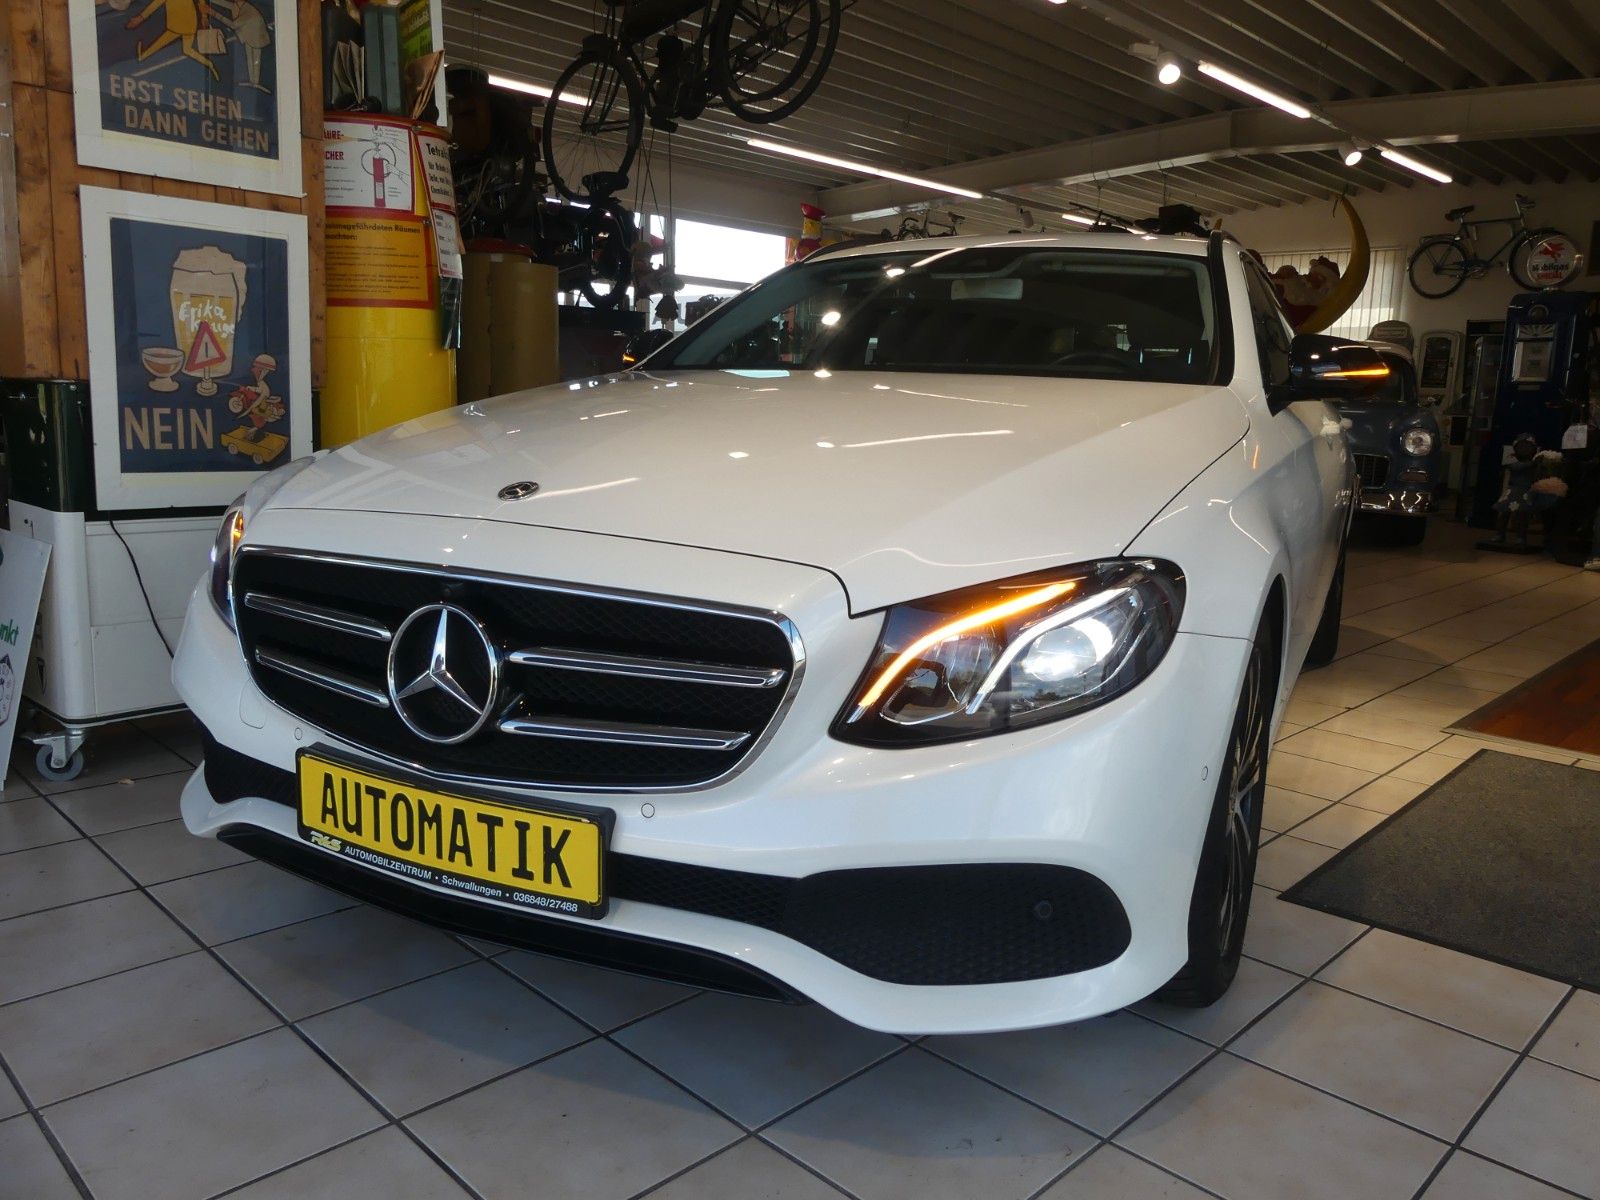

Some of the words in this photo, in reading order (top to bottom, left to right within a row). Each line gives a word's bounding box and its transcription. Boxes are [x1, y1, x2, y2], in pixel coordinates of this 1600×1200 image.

[109, 74, 164, 106] ERST
[173, 87, 242, 122] SEHEN
[124, 105, 188, 138] DANN
[201, 119, 269, 153] GEHEN
[124, 407, 214, 451] NEIN
[320, 771, 572, 889] AUTOMATIK
[344, 844, 432, 880] AUTOMOBILZENTRUM
[441, 874, 502, 898] Schwallungen
[512, 890, 579, 914] 036848/27488
